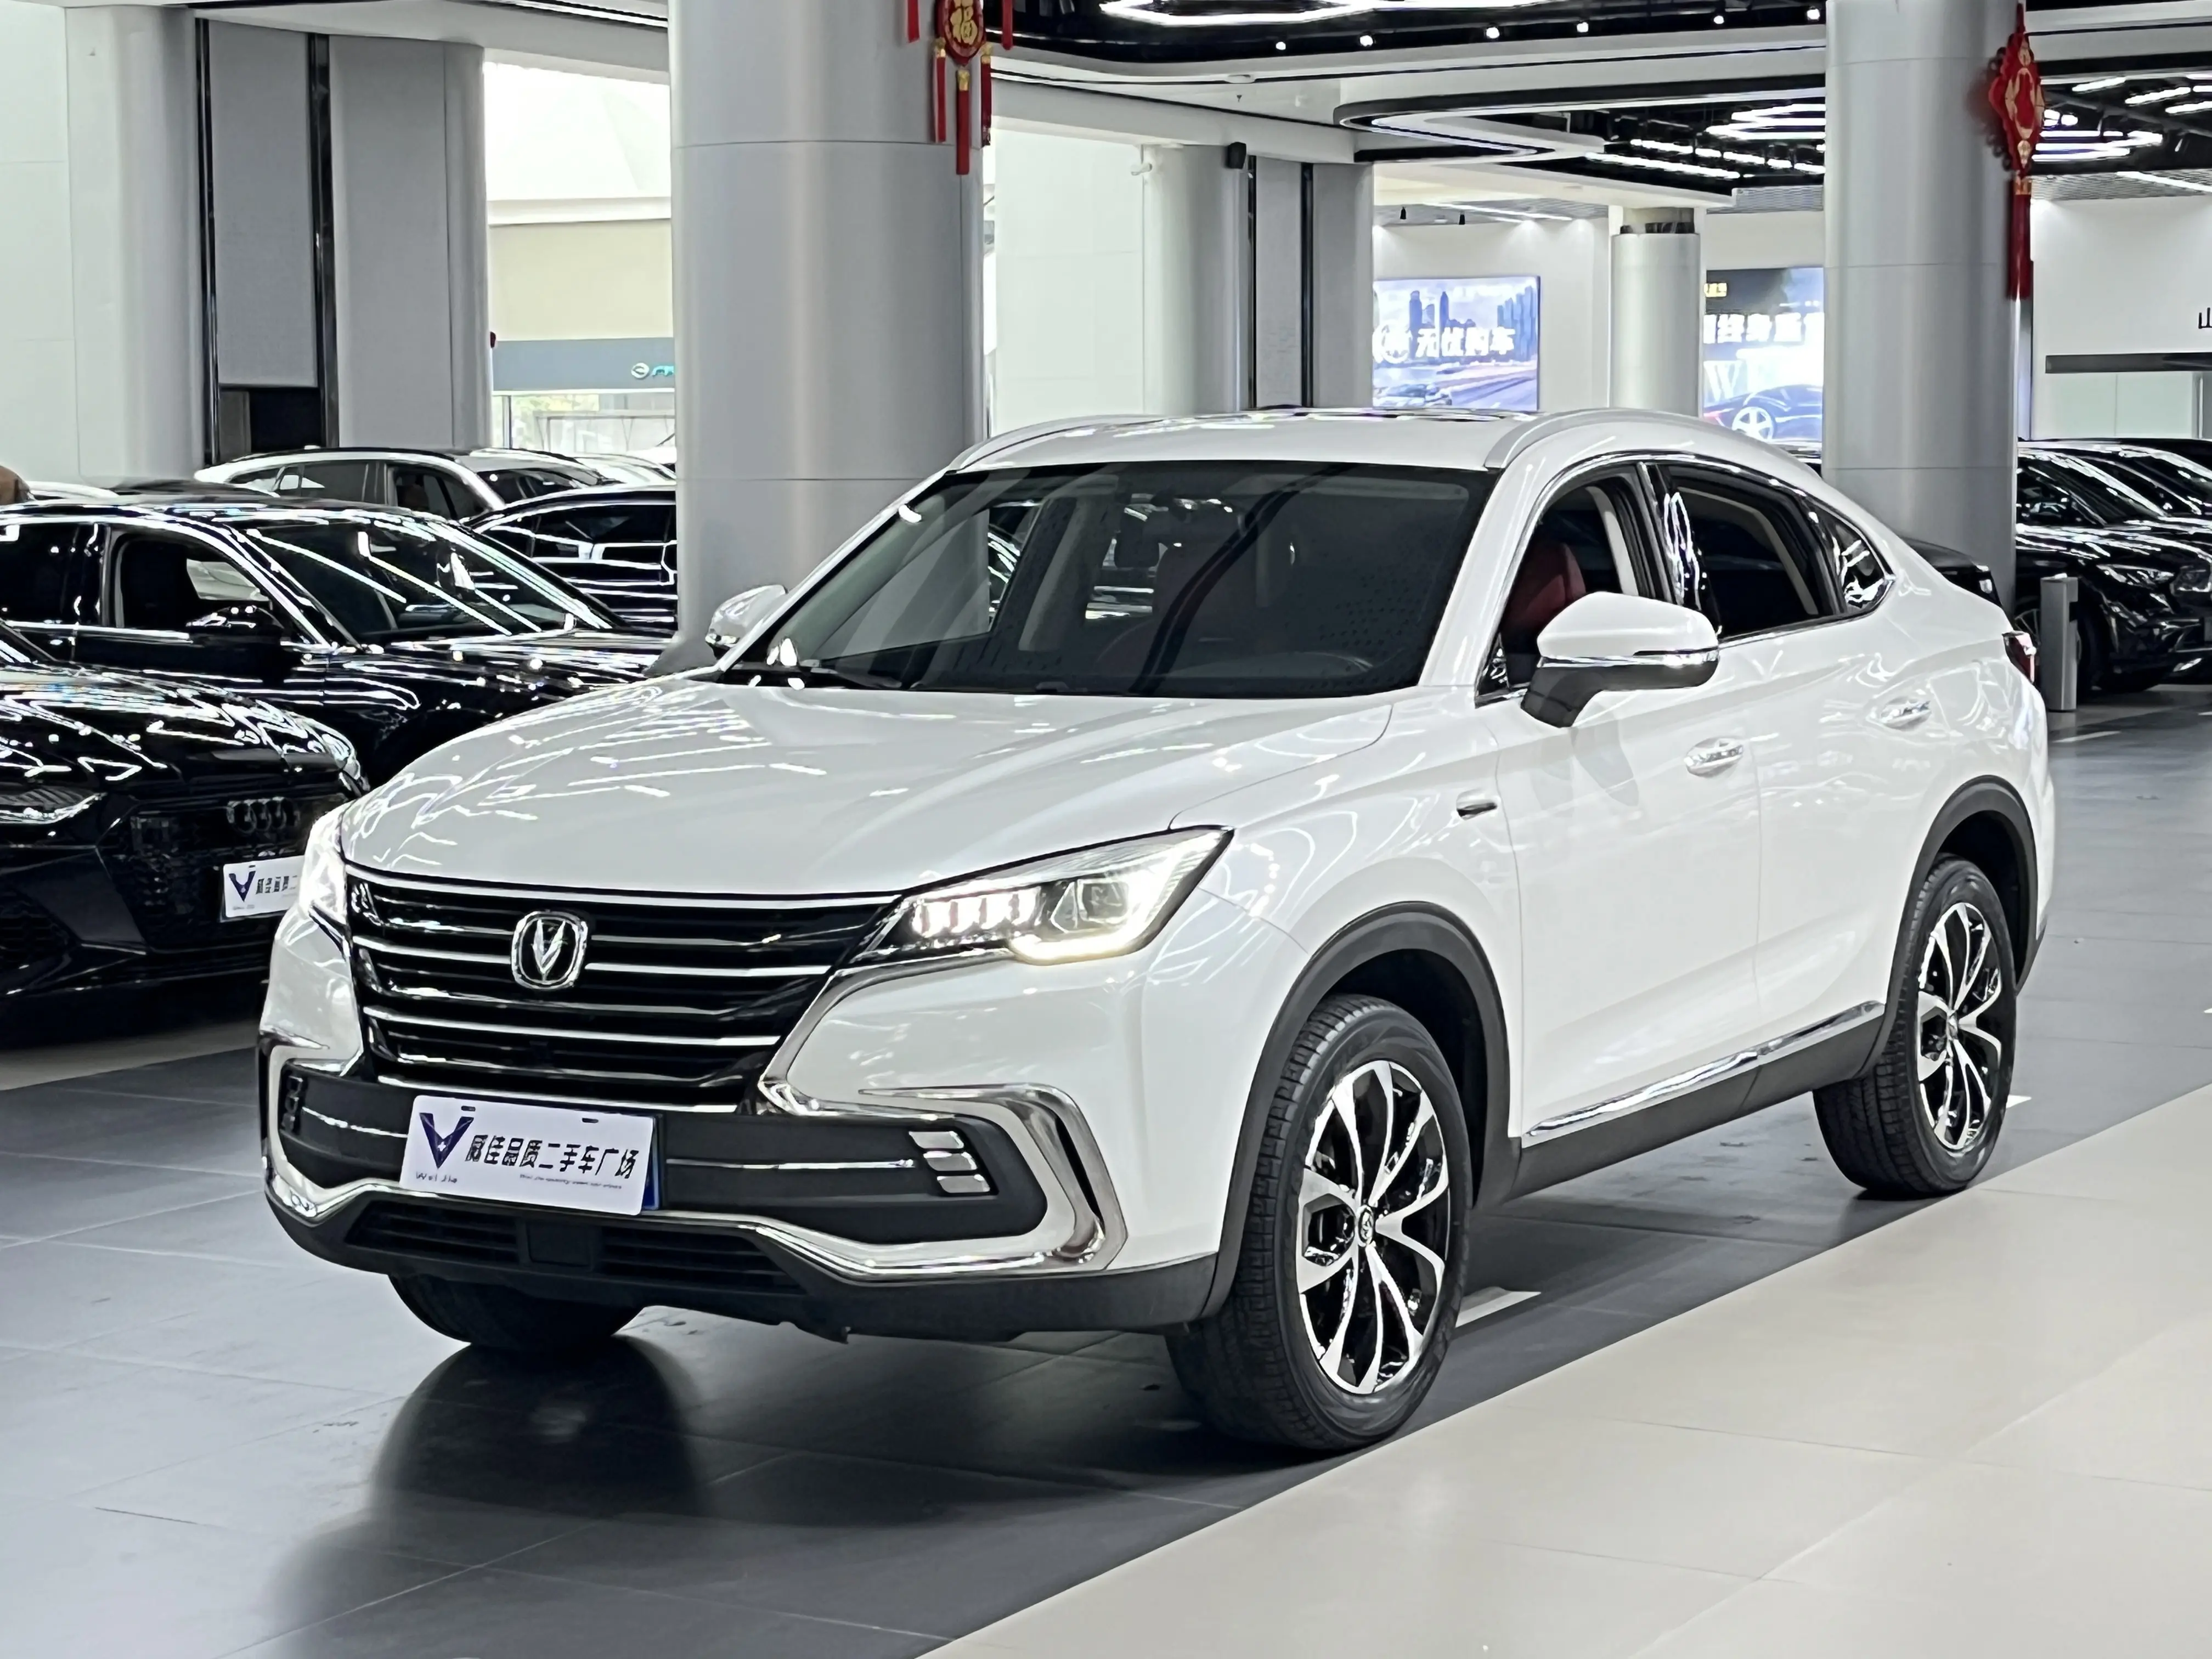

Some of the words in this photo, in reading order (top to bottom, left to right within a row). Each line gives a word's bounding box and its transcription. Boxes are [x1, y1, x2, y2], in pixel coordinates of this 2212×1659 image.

[465, 1135, 639, 1179] 威佳品质二手车广场
